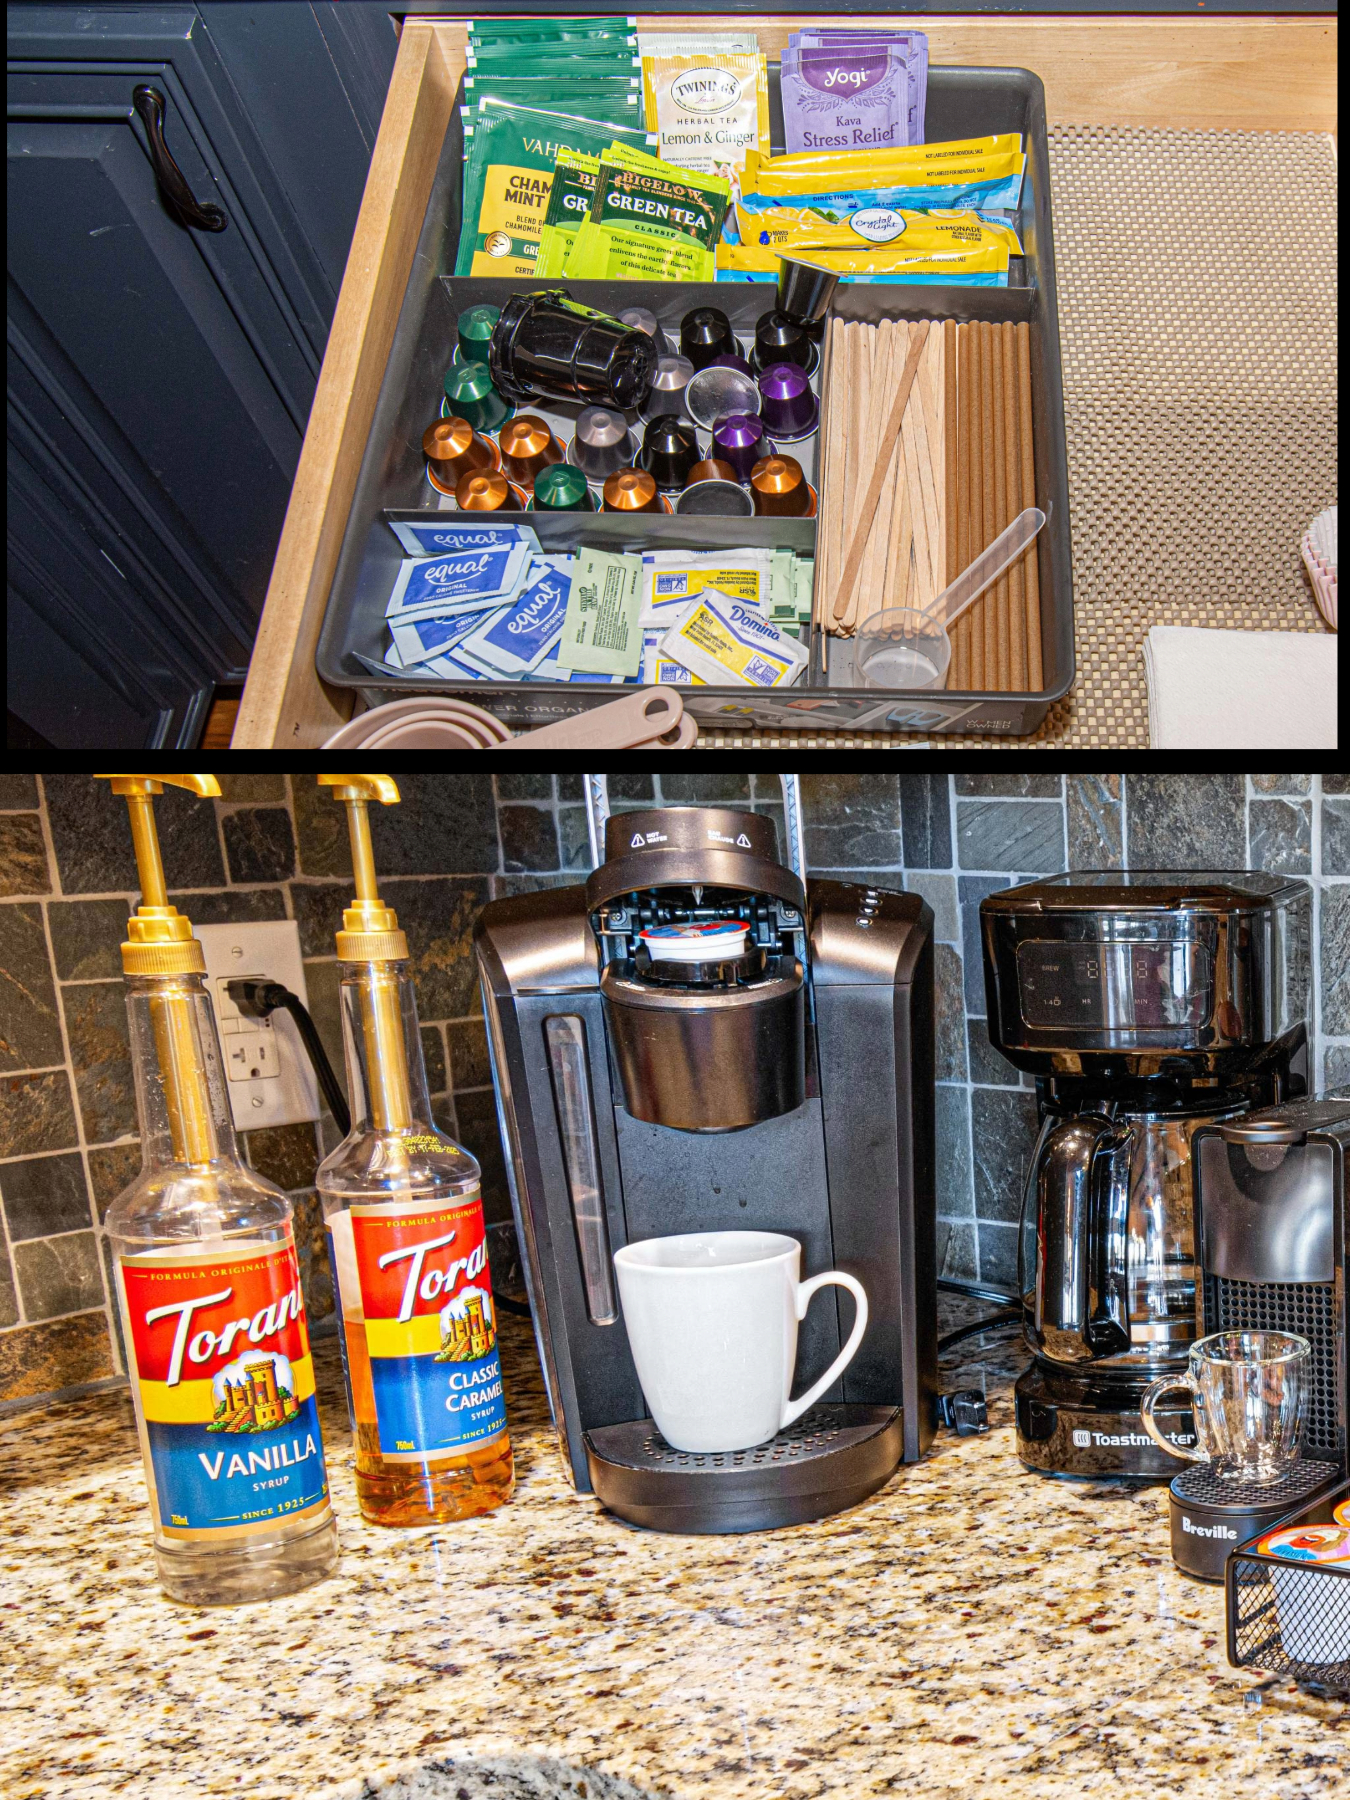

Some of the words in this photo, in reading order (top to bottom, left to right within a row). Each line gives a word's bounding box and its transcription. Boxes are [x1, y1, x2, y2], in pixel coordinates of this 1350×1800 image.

[676, 81, 737, 96] TWININGS
[824, 68, 868, 88] yogi
[662, 132, 700, 145] Lemon
[716, 131, 754, 147] Ginger
[803, 132, 848, 147] Stress
[852, 122, 896, 144] Relief
[622, 171, 703, 202] BIGELOW
[504, 189, 545, 208] MINT
[607, 192, 669, 220] GREEN
[673, 208, 708, 230] TEA
[634, 224, 676, 238] CLASSIC
[855, 215, 892, 230] Crystal
[625, 239, 655, 251] signature
[434, 531, 502, 549] equal
[424, 554, 488, 583] equal
[507, 584, 561, 634] equal
[541, 608, 566, 632] ORIGINAL
[729, 605, 780, 640] Domino
[210, 1260, 272, 1277] ORIGINALE
[448, 1360, 500, 1392] CLASSIC
[470, 1406, 495, 1421] SYRUP
[461, 1428, 485, 1440] SINCE
[487, 1418, 503, 1434] 1925
[1092, 1432, 1196, 1446] Toastmater
[197, 1433, 317, 1481] VANILLA
[252, 1475, 290, 1492] SYRUP
[241, 1507, 274, 1520] SINCE
[276, 1496, 305, 1514] 1925
[1182, 1516, 1238, 1541] Breville
